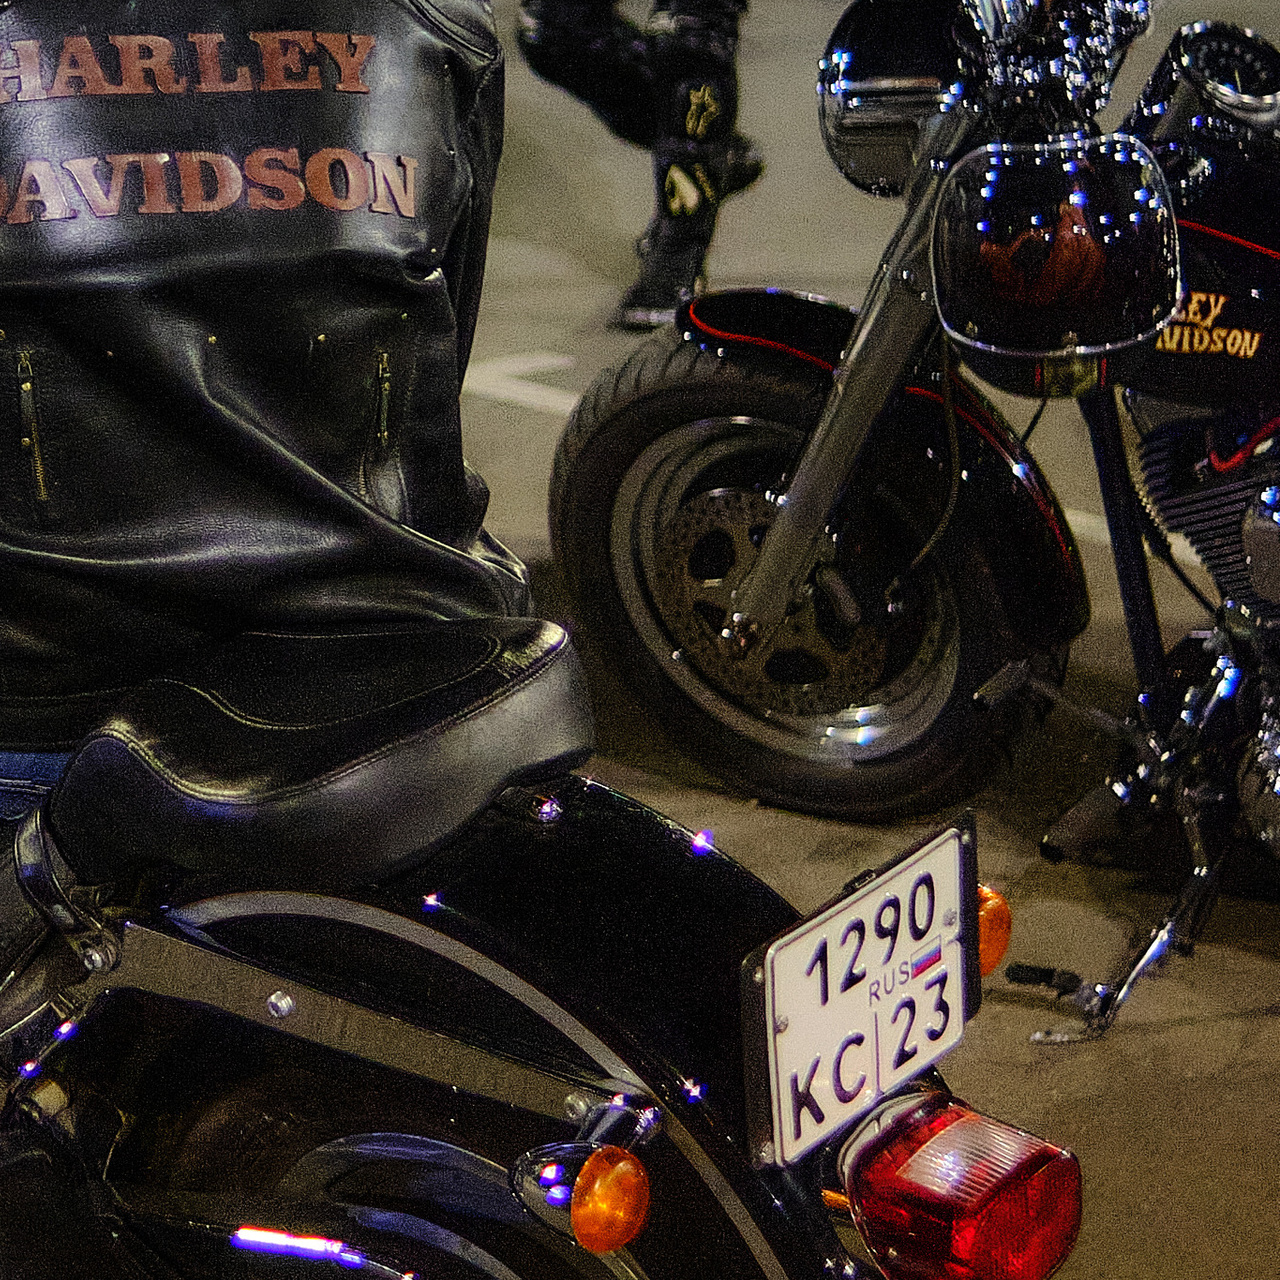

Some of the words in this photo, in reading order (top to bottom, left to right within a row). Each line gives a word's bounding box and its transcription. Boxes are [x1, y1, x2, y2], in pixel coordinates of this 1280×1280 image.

[805, 870, 936, 1006] 1290
[868, 961, 910, 1007] RUS
[891, 965, 950, 1071] 23
